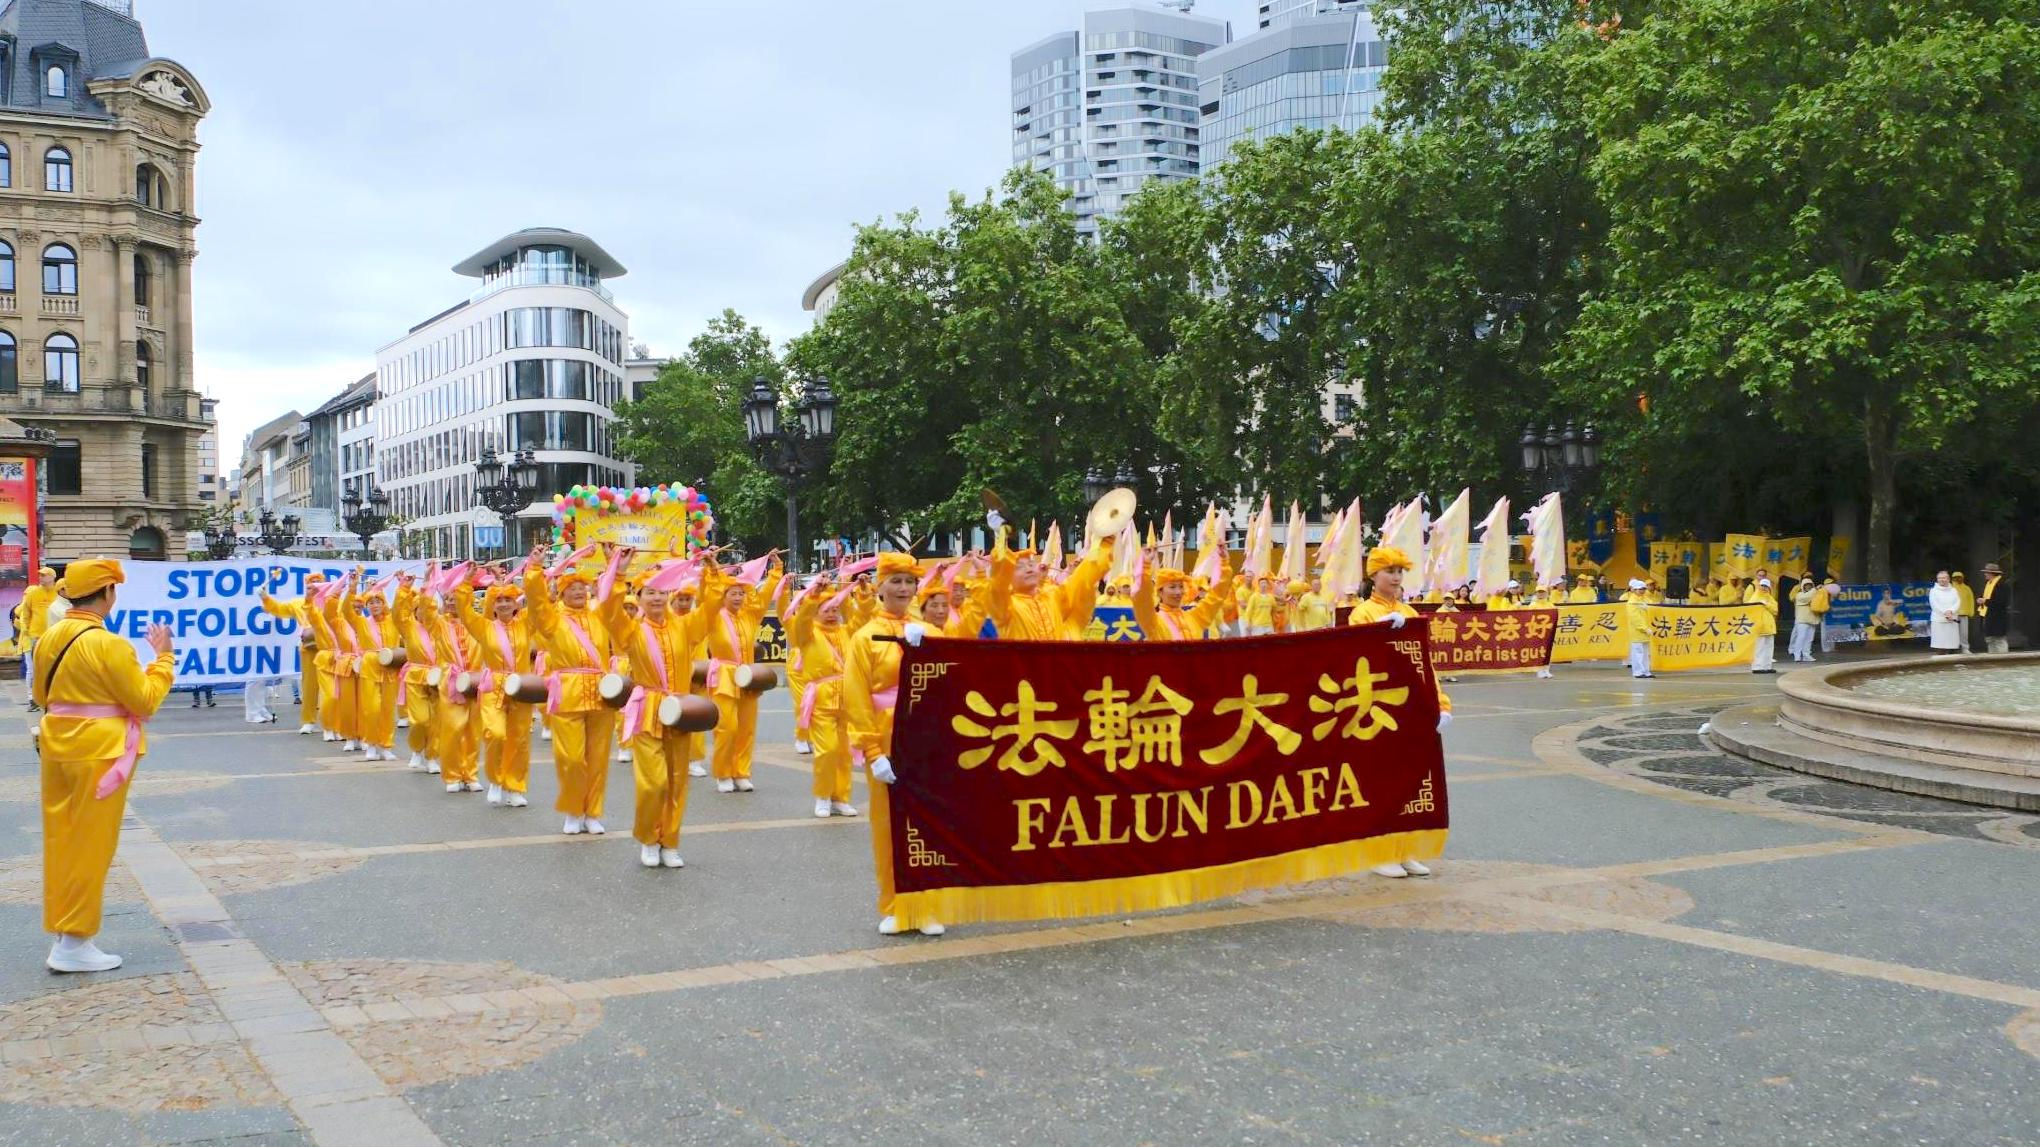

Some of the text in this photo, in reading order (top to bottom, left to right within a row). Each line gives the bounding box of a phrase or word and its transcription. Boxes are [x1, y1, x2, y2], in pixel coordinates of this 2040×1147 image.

[167, 566, 311, 599] STOPPT
[1838, 588, 1873, 601] alun
[104, 605, 298, 639] VERFOLGU
[1651, 613, 1756, 640] 法輪大法
[1453, 645, 1492, 664] Dafa
[1496, 645, 1518, 662] ist
[1520, 645, 1547, 664] gut
[1698, 641, 1736, 655] DAFA
[951, 656, 1409, 776] 法輪大法
[1010, 762, 1369, 852] FALUN DAFA
